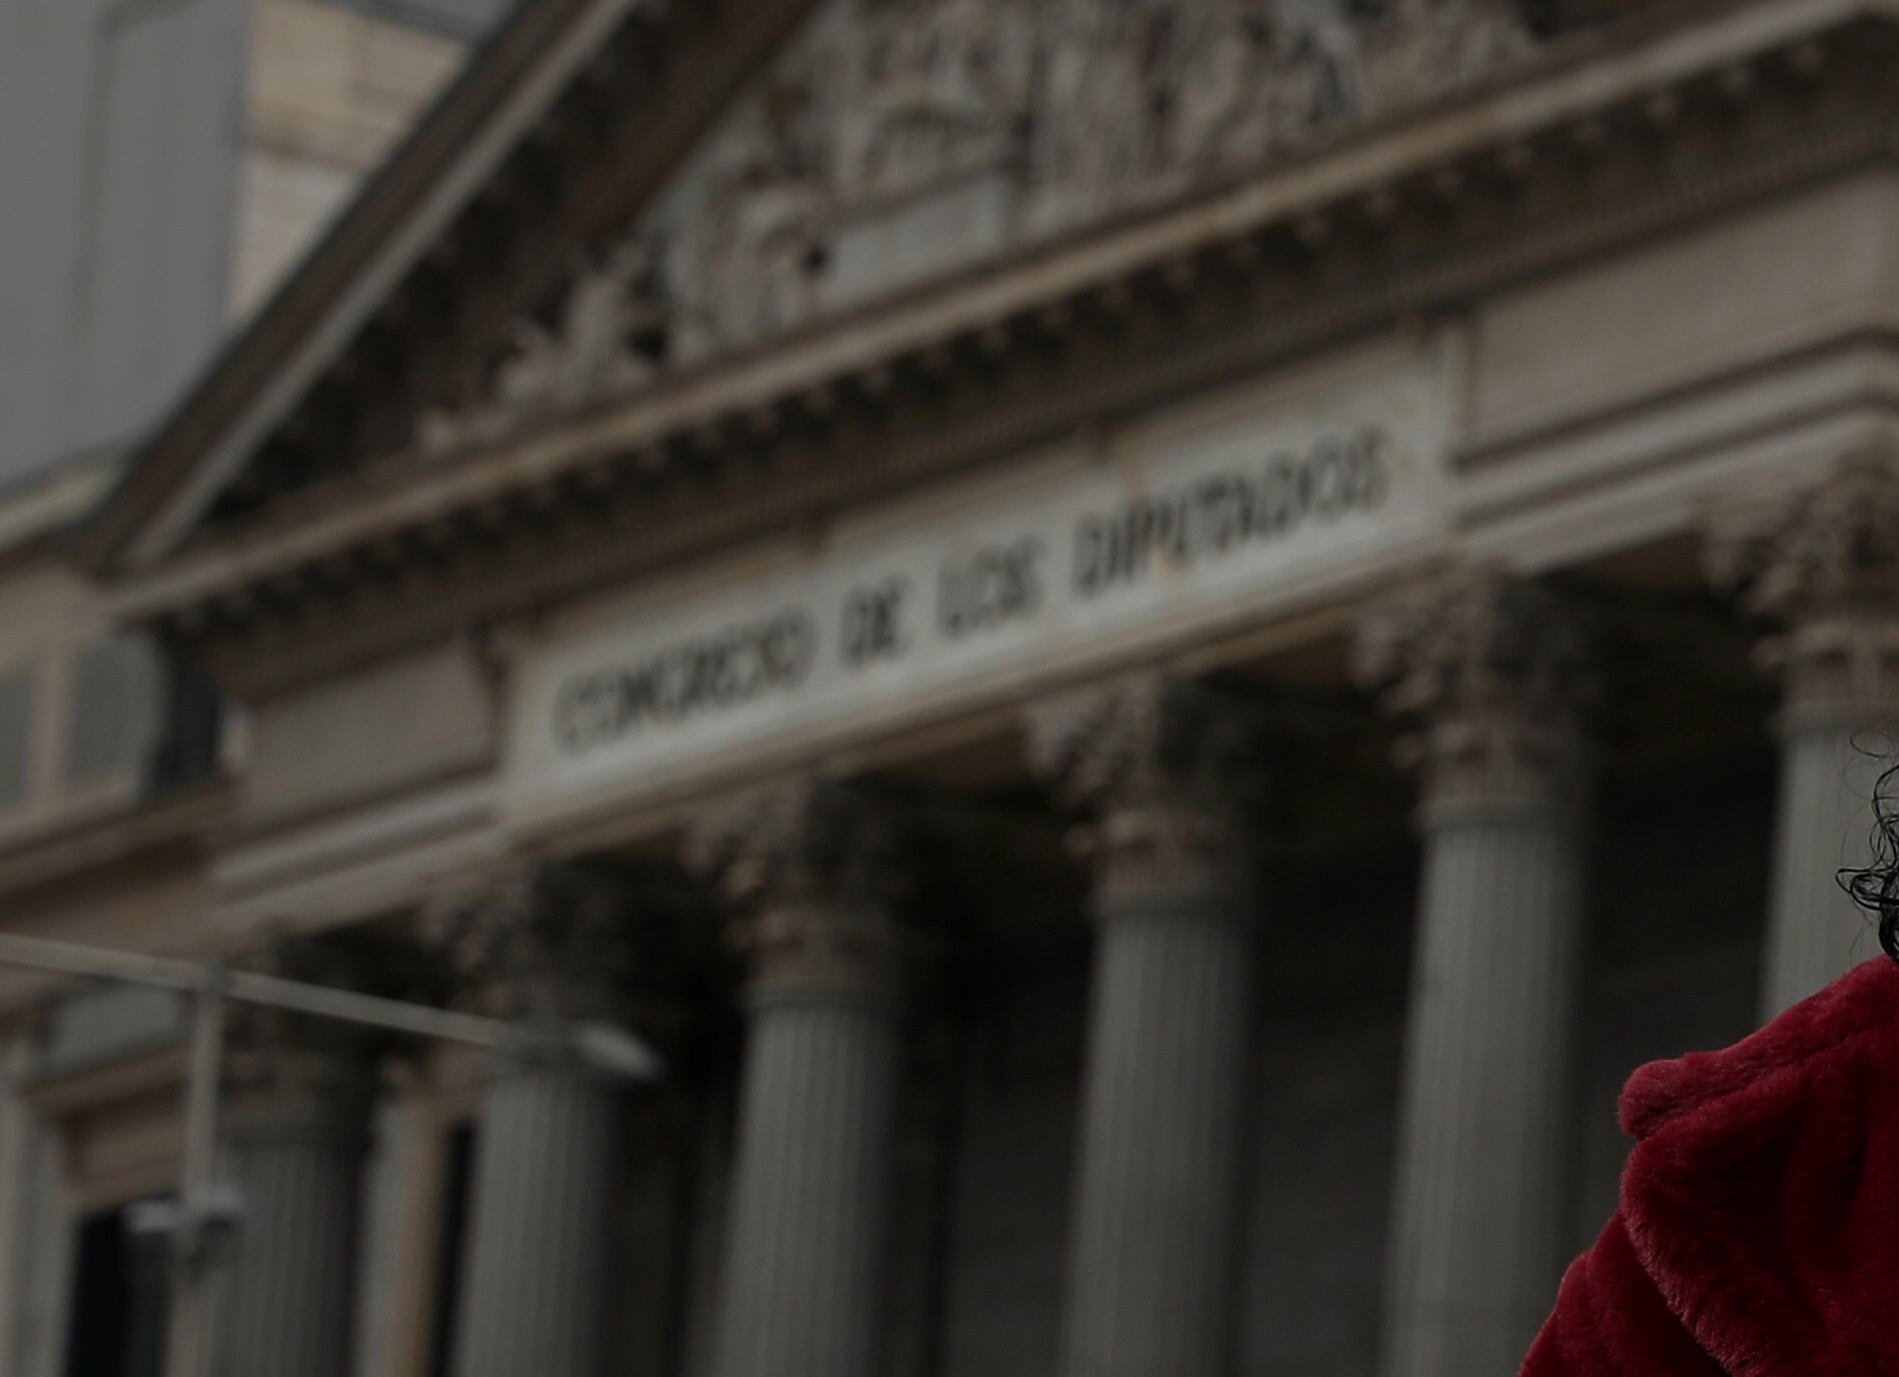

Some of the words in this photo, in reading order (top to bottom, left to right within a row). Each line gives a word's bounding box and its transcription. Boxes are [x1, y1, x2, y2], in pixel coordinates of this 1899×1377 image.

[840, 574, 908, 667] DE
[936, 536, 1043, 640] LOS
[1072, 424, 1390, 596] DIPUTADOS
